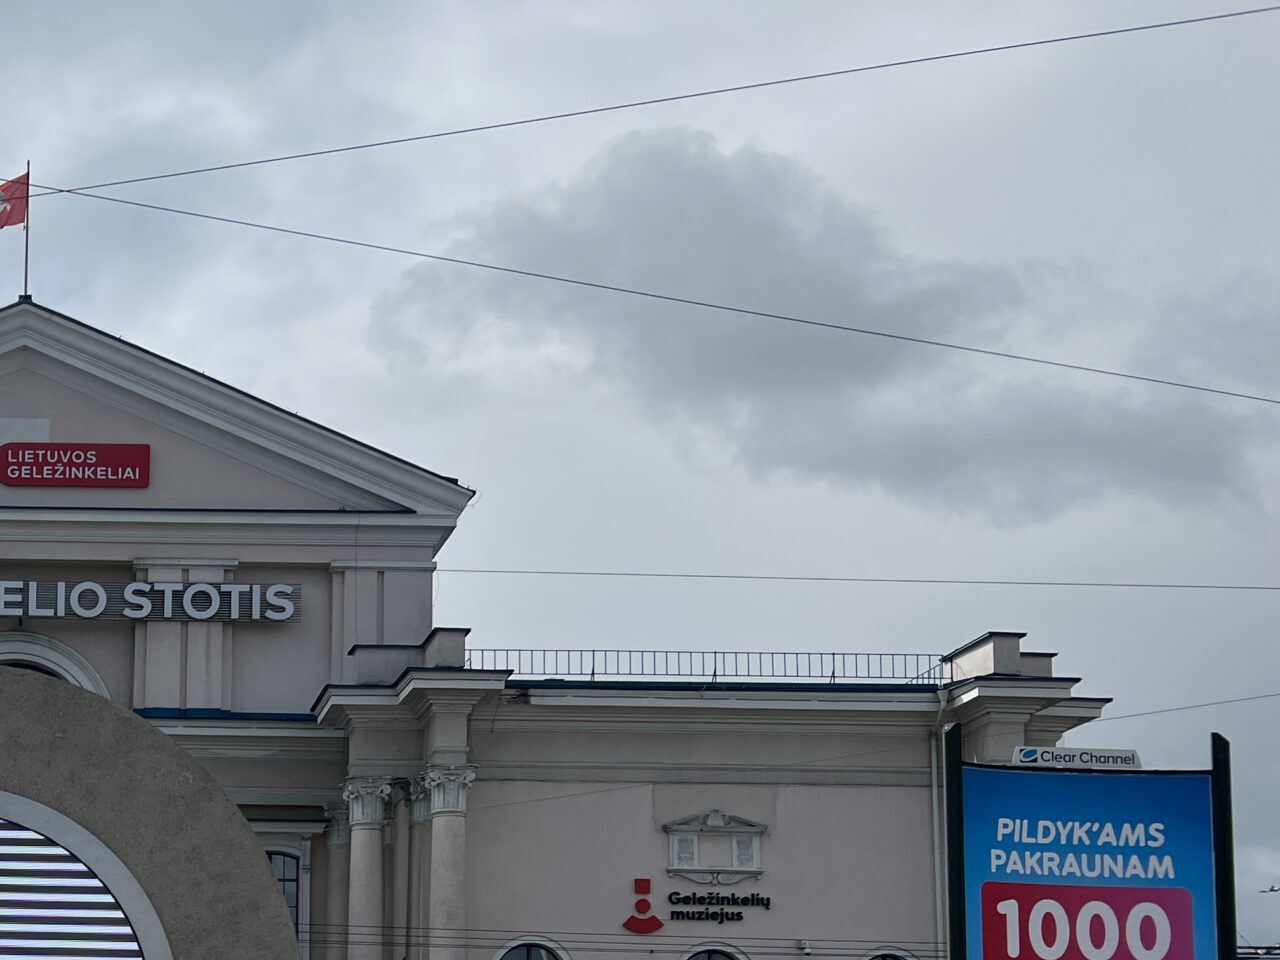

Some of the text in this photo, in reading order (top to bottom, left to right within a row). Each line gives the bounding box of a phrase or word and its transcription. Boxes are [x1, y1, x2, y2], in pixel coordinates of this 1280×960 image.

[7, 449, 97, 463] LIETUVOS
[7, 463, 140, 480] GELEŽINKELIAI
[122, 580, 295, 621] STOTIS
[1040, 750, 1136, 765] Clear Channel
[996, 817, 1166, 848] PILDYK'AMS
[989, 848, 1175, 880] PAKRAUNAM
[668, 891, 771, 911] Geležinkelių
[670, 907, 744, 925] muziejus
